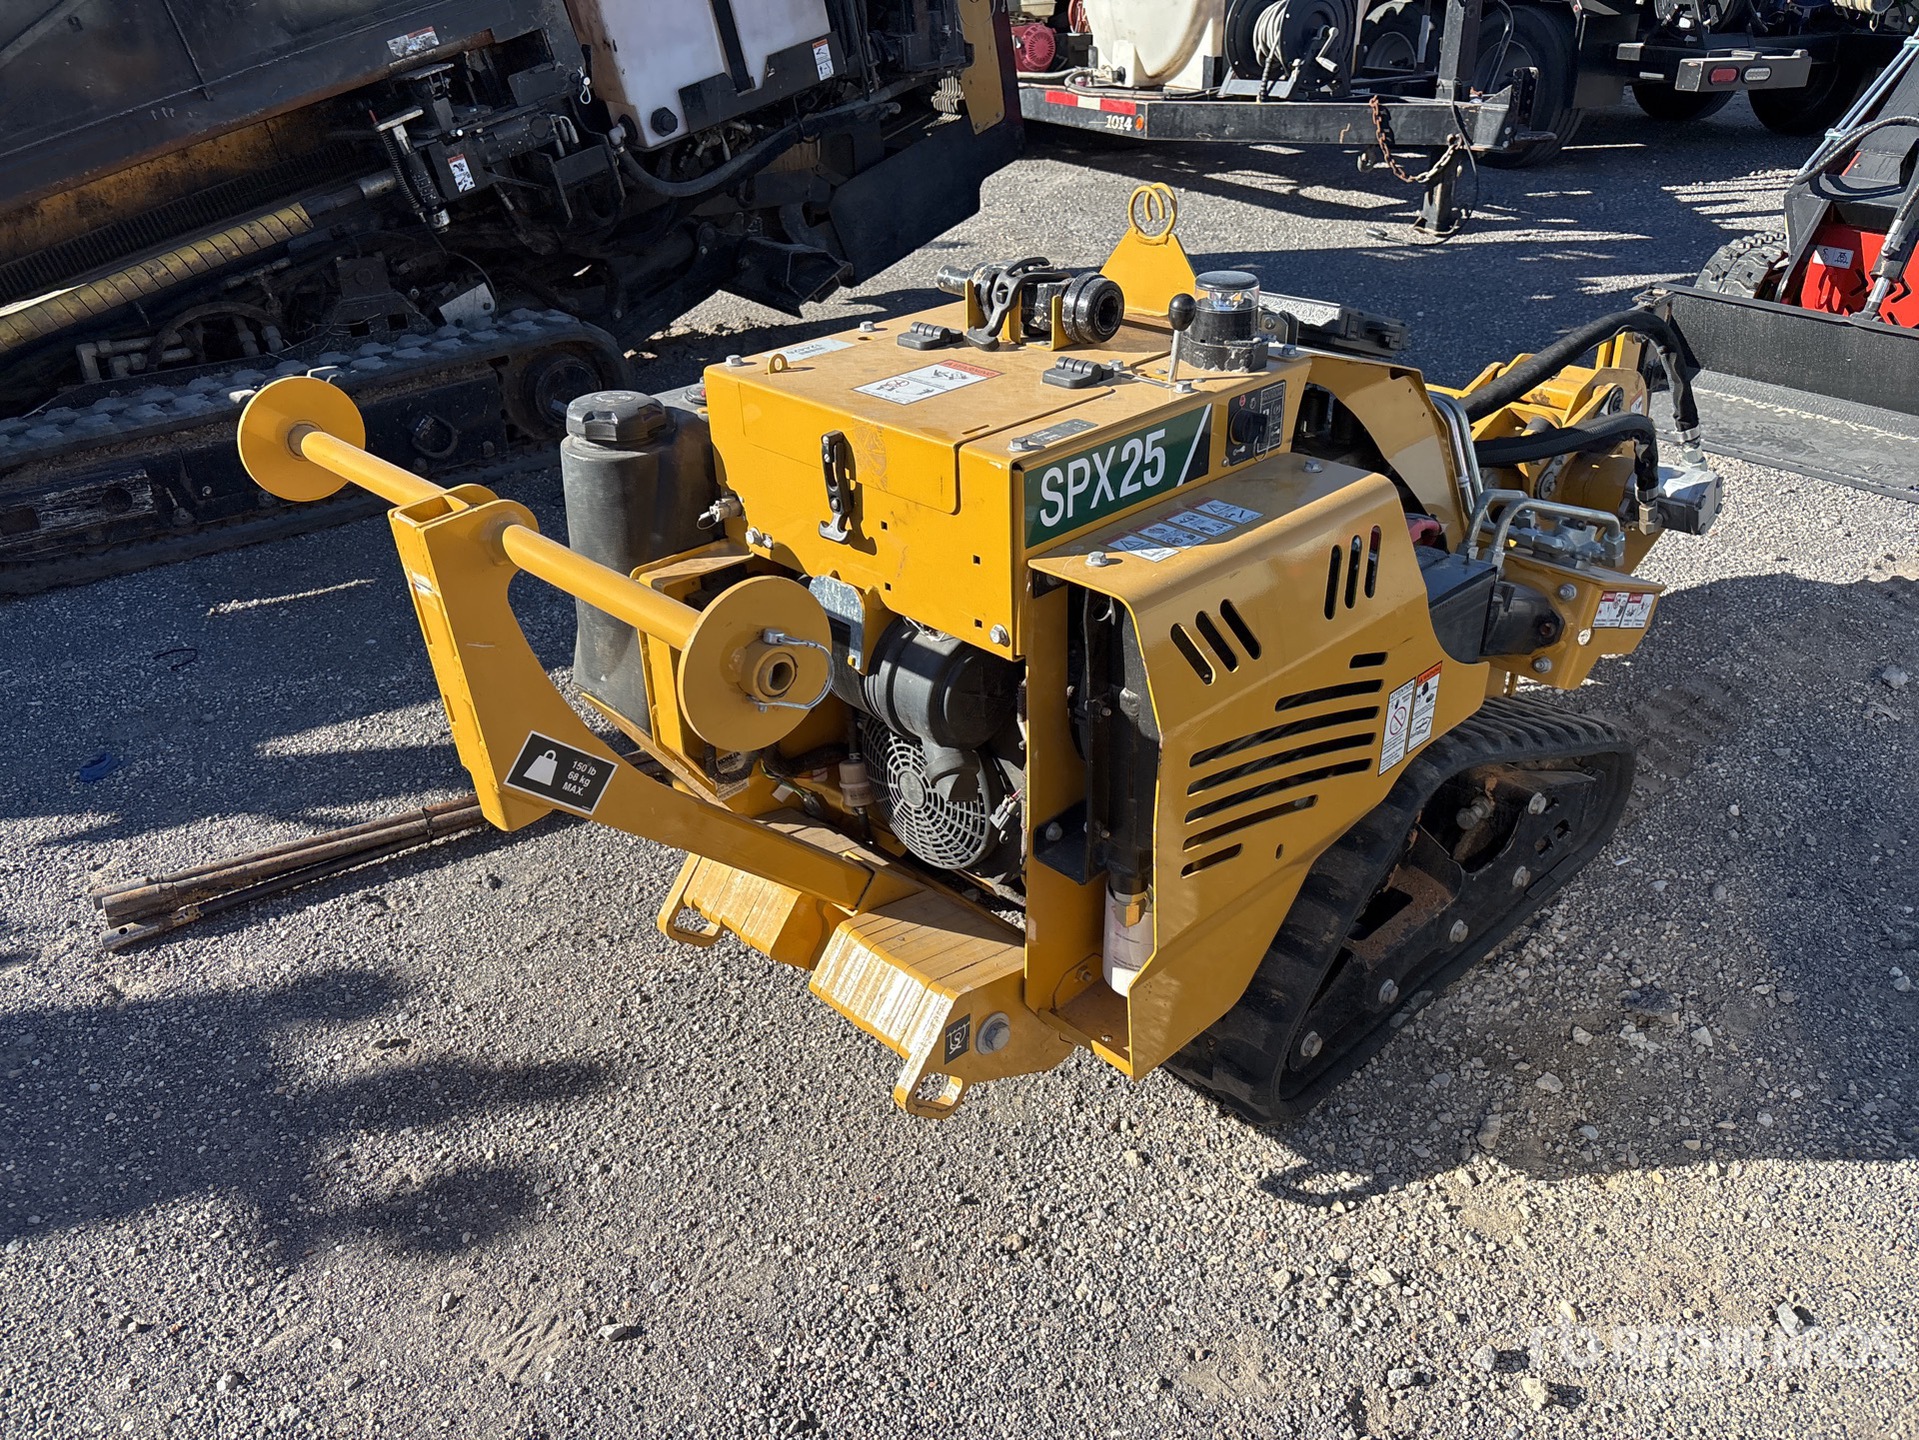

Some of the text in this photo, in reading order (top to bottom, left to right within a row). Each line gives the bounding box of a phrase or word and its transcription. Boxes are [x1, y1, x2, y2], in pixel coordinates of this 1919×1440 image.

[1105, 114, 1133, 131] 1014
[1039, 428, 1167, 528] SPX25
[572, 760, 597, 776] 150 lb
[567, 771, 591, 788] 68 kg
[562, 781, 584, 797] MAX.
